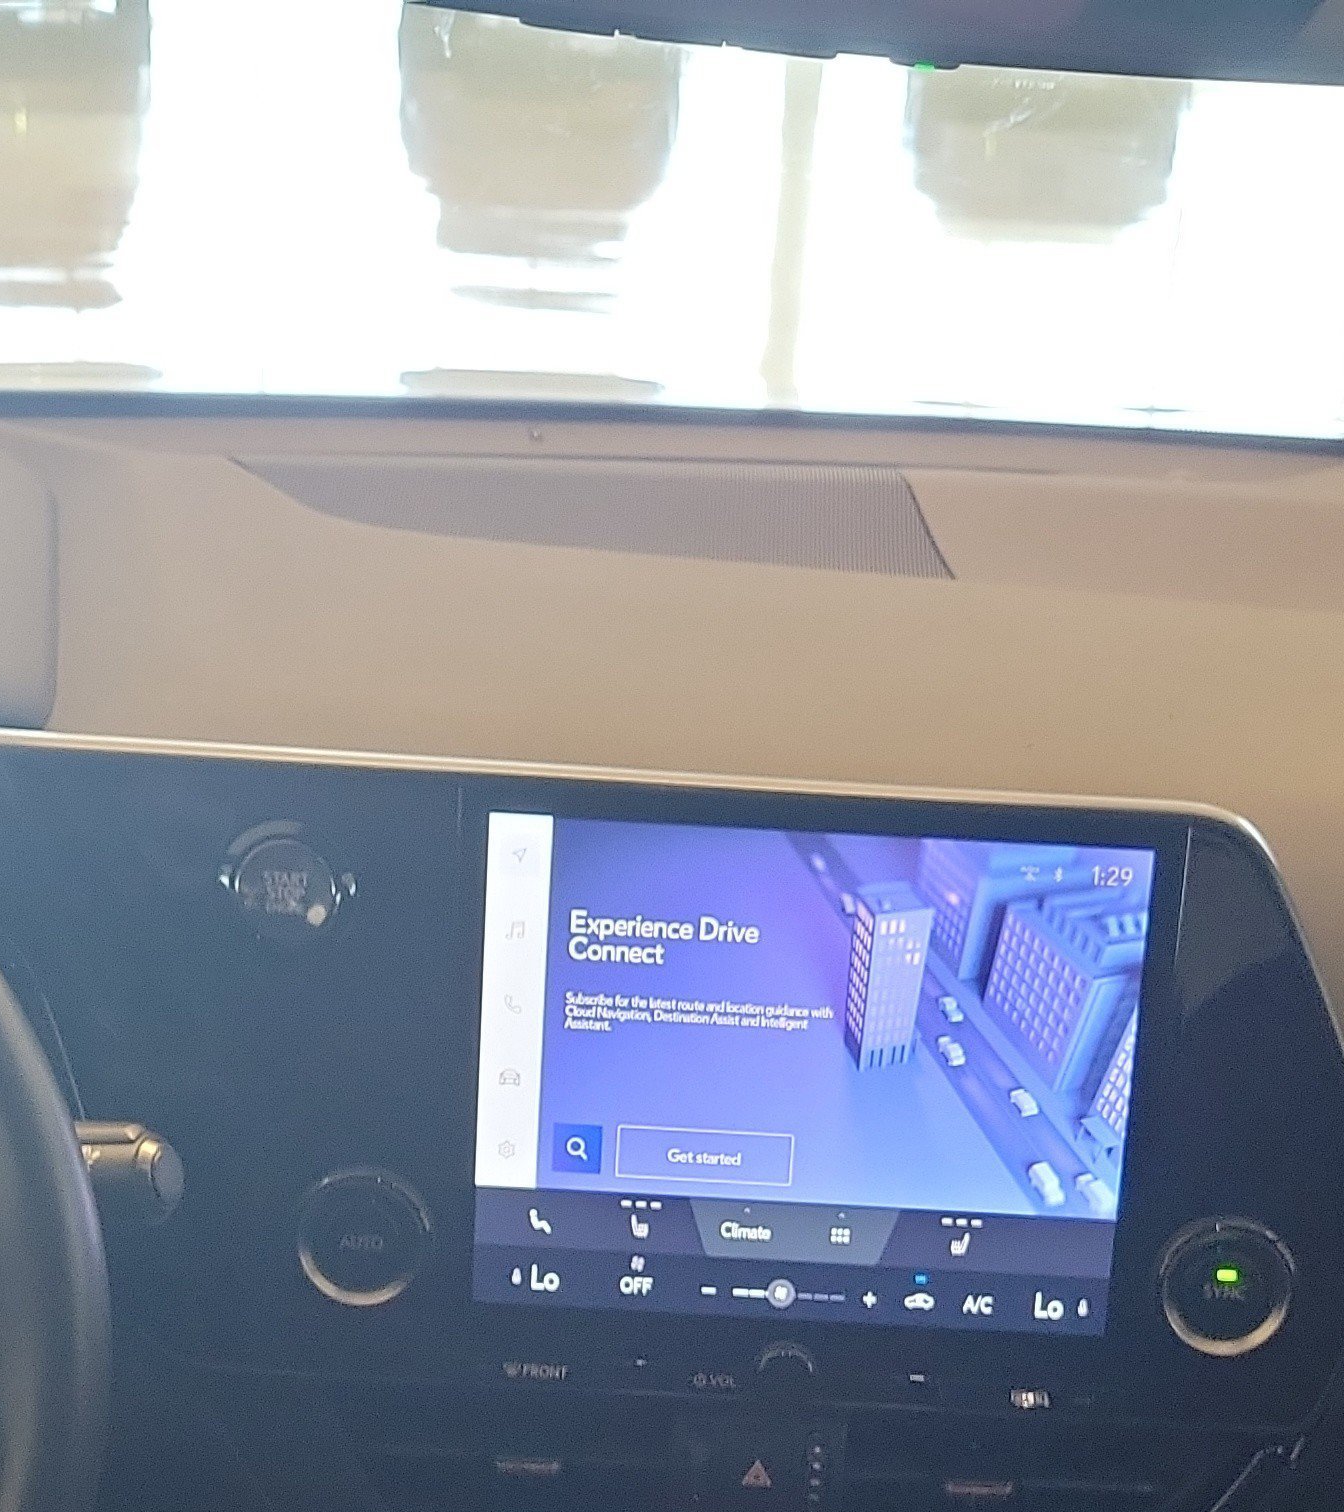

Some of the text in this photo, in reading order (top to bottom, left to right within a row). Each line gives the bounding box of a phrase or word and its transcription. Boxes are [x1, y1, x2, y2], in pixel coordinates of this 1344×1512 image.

[1092, 865, 1133, 886] 1:29
[570, 908, 760, 944] Experience Drive
[568, 936, 665, 965] Connect
[565, 991, 833, 1019] Subscribe for the latest route and location guidance with
[564, 1017, 612, 1031] Assistant.
[565, 1004, 808, 1031] Cloud Navigation, Destination Assist and Intelligent
[667, 1148, 741, 1167] Get started
[720, 1221, 772, 1241] Climate
[530, 1263, 560, 1292] Lo
[619, 1275, 654, 1296] OFF
[962, 1294, 994, 1315] A/C
[1033, 1290, 1064, 1320] Lo
